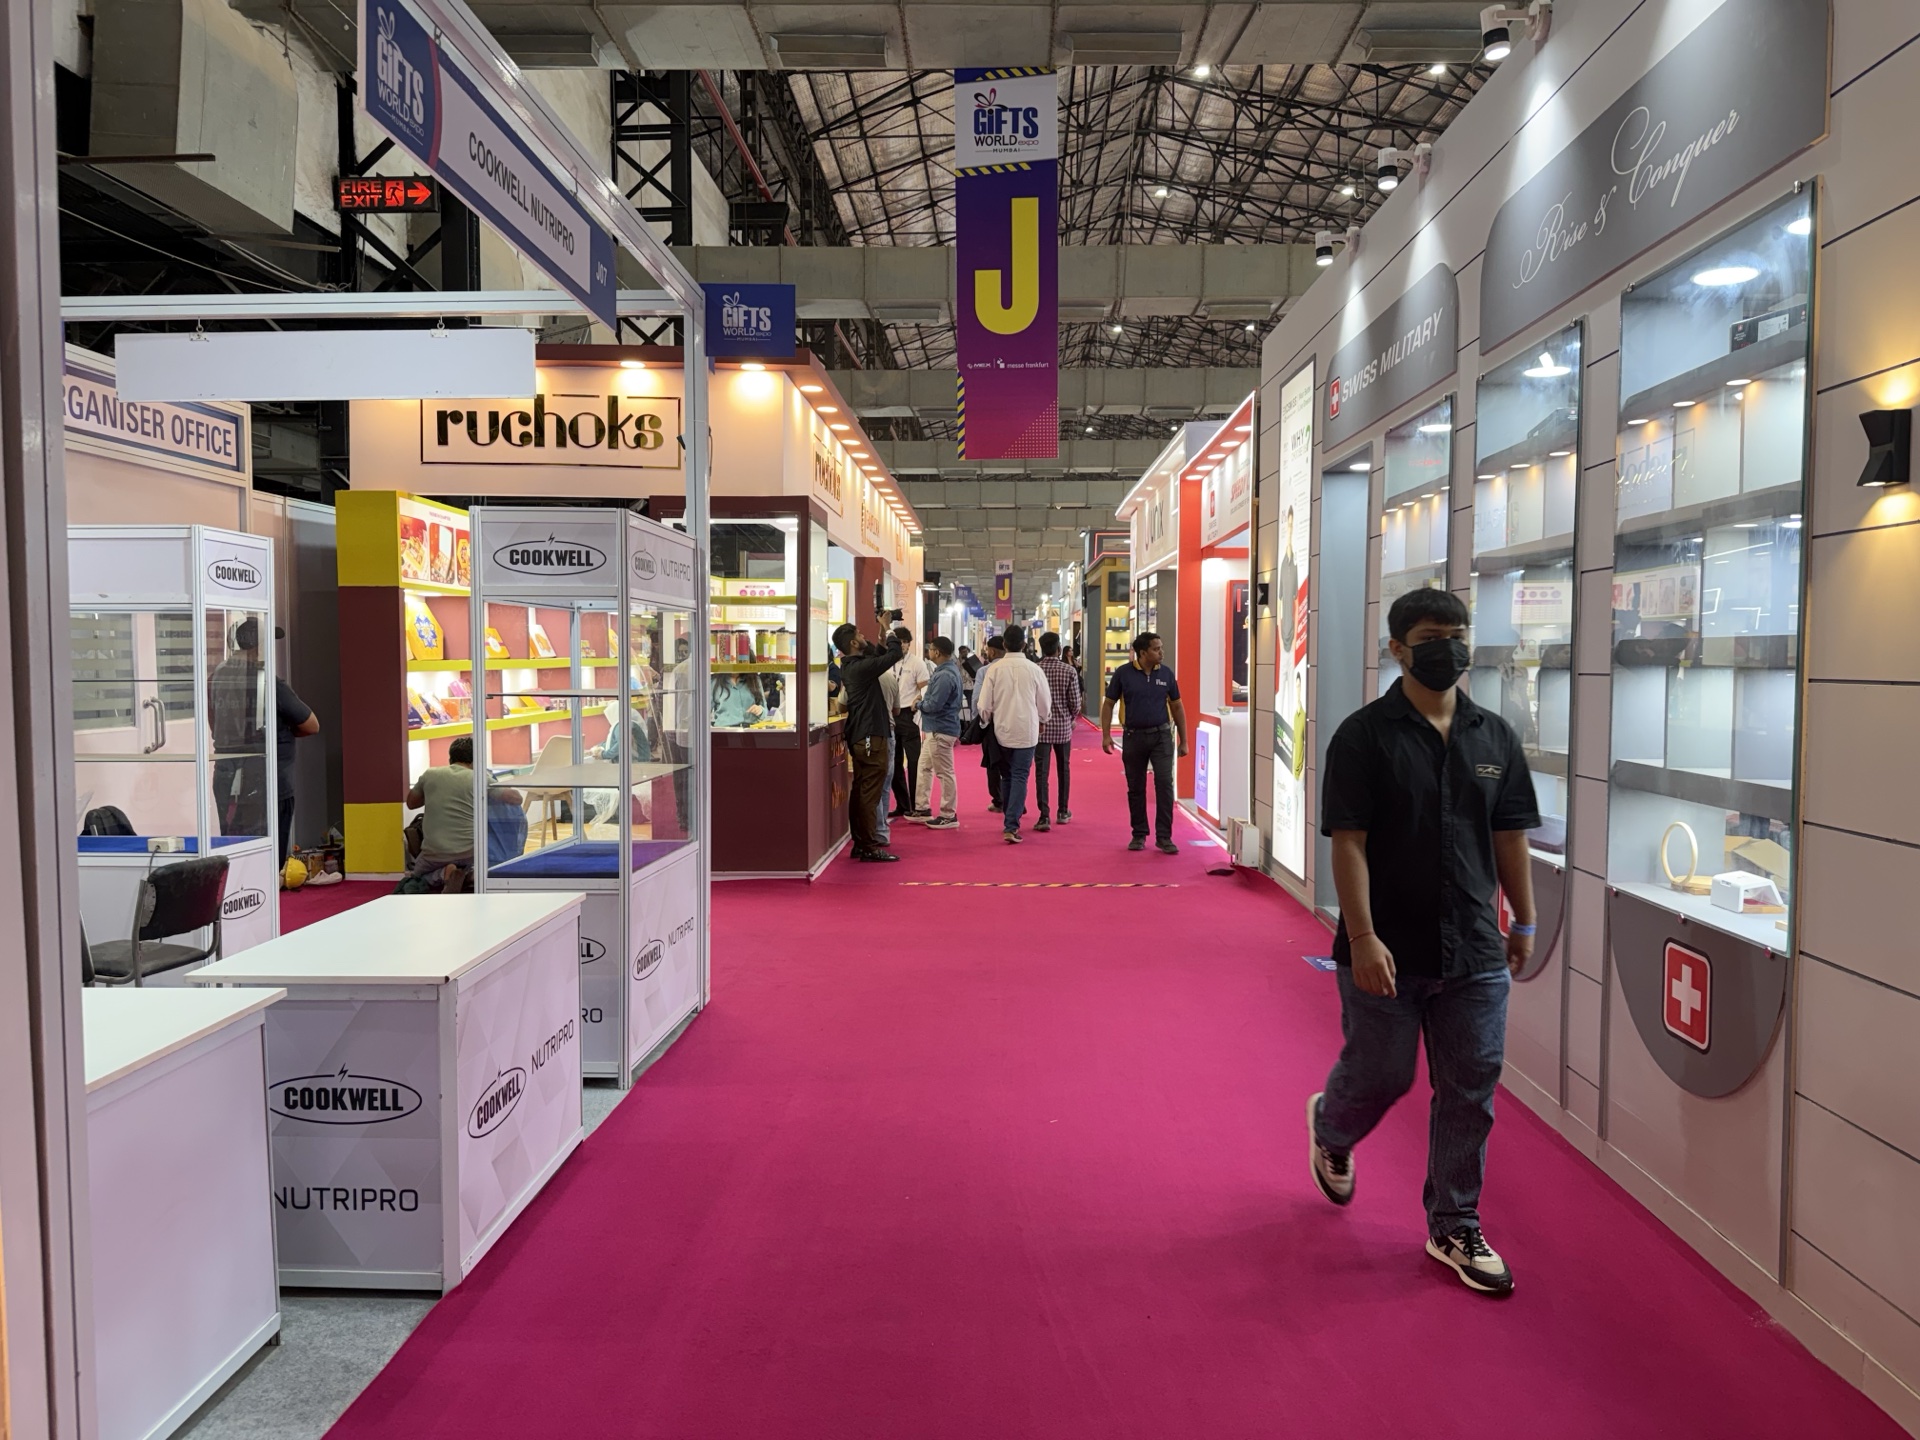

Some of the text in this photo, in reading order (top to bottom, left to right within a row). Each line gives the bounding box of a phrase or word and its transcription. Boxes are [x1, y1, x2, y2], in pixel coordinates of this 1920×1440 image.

[378, 79, 410, 122] WORLD
[974, 135, 1018, 146] WORLD
[340, 181, 382, 193] FIRE
[469, 131, 575, 256] COOKWELL NUTRIPRO
[1512, 106, 1740, 289] Rise & Conquer
[341, 195, 382, 207] EXIT
[596, 261, 608, 287] J07
[975, 197, 1039, 335] J
[723, 327, 756, 336] WORLD
[1342, 358, 1378, 403] SWISS
[1380, 307, 1444, 375] MILITARY
[62, 384, 232, 457] GANISER OFFICE
[437, 394, 664, 449] ruchoks
[509, 549, 594, 567] COOKWELL
[660, 557, 691, 582] NUTRIPRO
[215, 565, 256, 583] COOKWELL
[998, 578, 1010, 601] J
[223, 892, 261, 915] COOKWELL
[636, 916, 694, 975] COOKWELL NUTRIPRO
[476, 1018, 574, 1130] COOKWELL NUTRIPRO
[284, 1086, 404, 1111] COOKWELL
